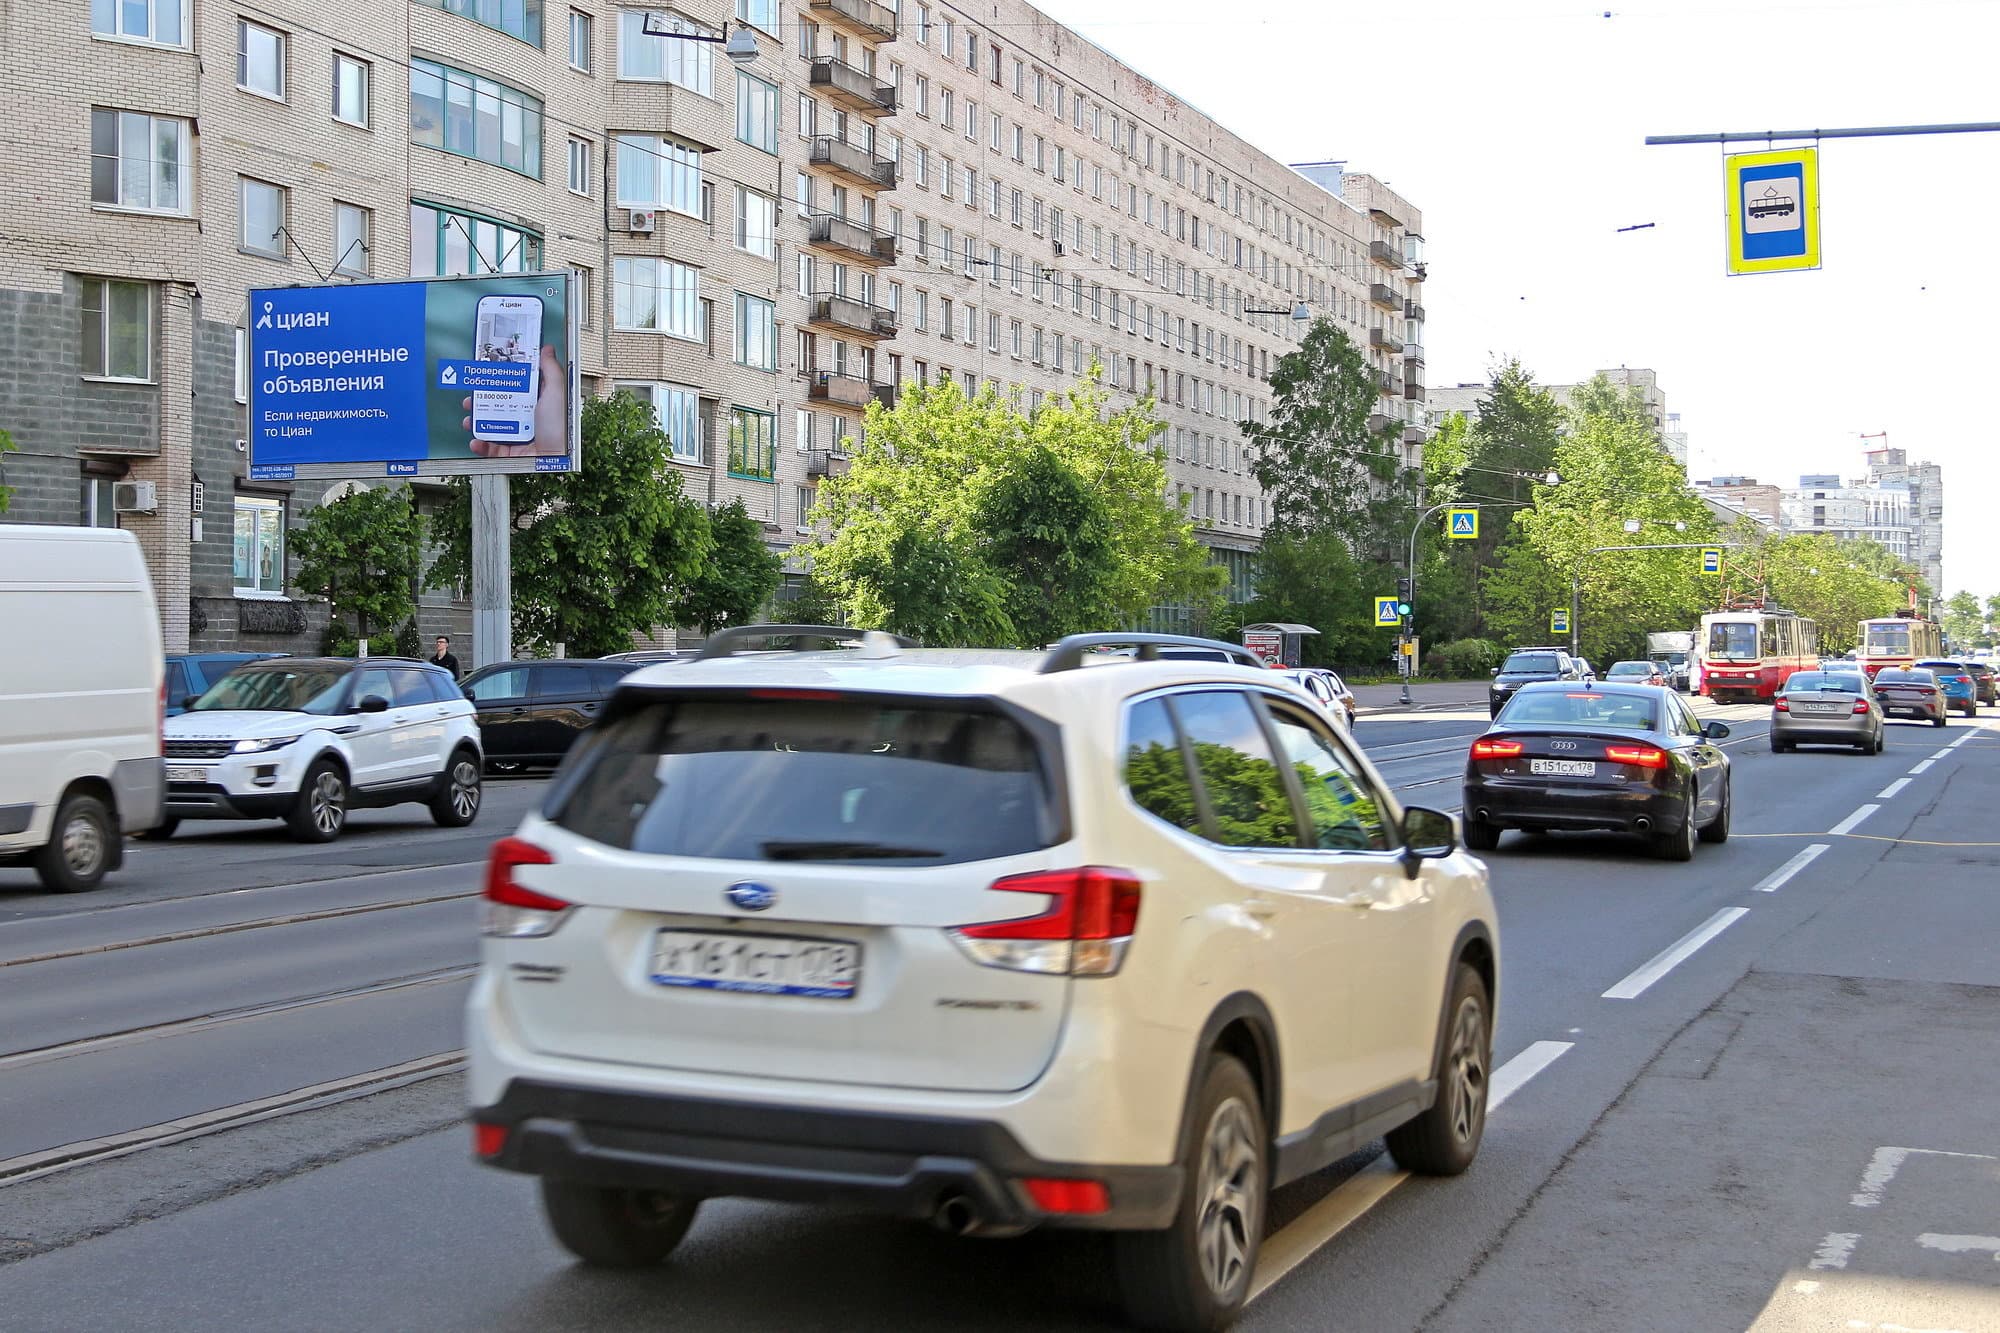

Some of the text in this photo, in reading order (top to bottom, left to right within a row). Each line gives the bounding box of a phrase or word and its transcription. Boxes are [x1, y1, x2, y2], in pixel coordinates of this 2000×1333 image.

[546, 287, 559, 297] 0+
[276, 311, 330, 330] циан
[264, 347, 409, 371] Проверенные
[463, 365, 527, 377] Проверенный
[263, 375, 384, 394] объявления
[463, 376, 522, 388] Собственник
[264, 408, 389, 422] Если недвижимость,
[264, 426, 313, 439] то Циан
[486, 423, 514, 431] Позвонить
[397, 464, 415, 472] Russ
